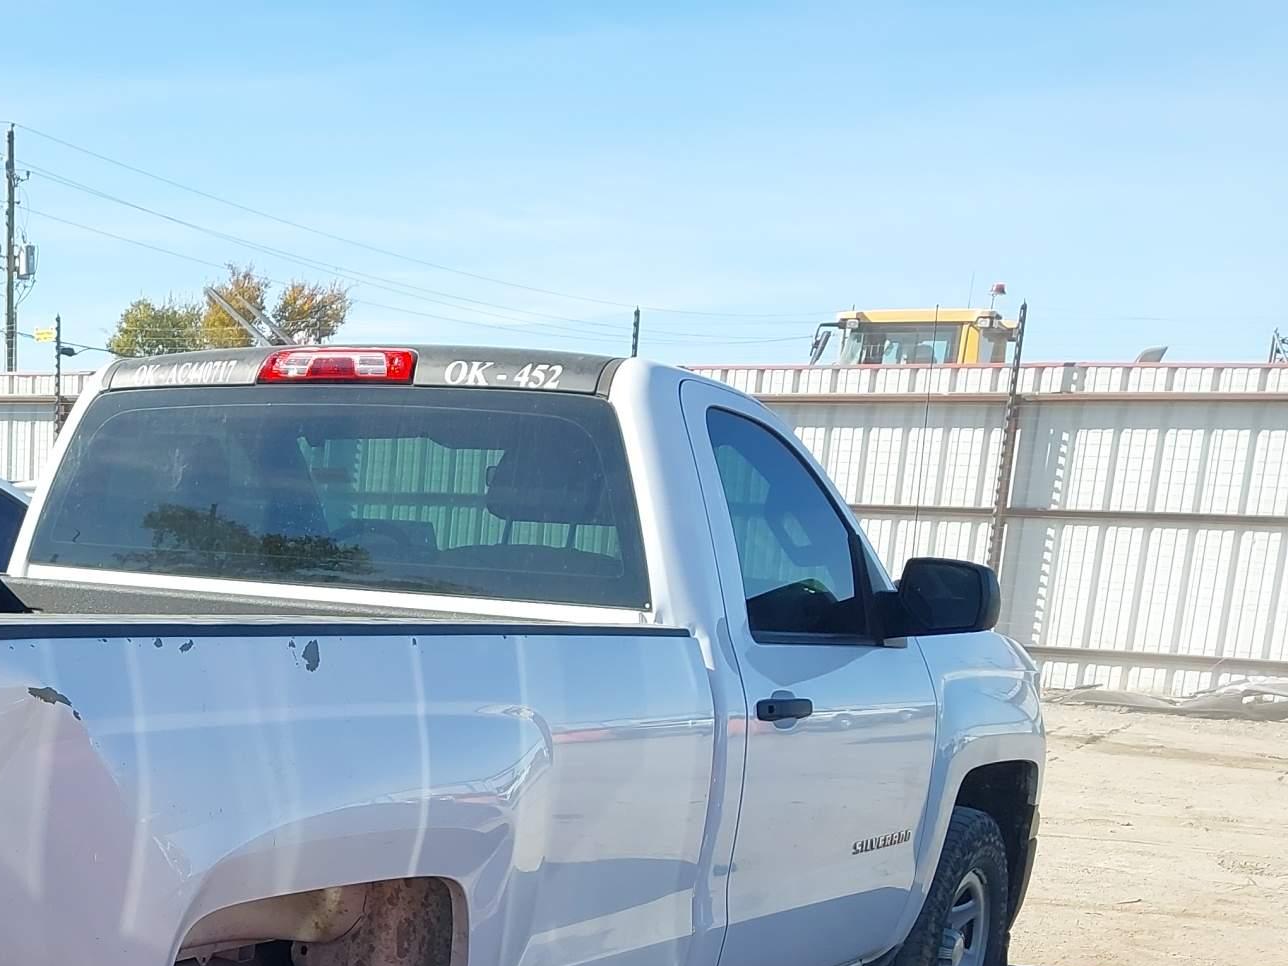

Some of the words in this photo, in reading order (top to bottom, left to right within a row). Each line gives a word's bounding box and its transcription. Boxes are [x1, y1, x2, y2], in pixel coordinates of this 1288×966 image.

[134, 365, 160, 385] OK
[444, 360, 487, 386] OK
[513, 364, 562, 389] 452
[852, 829, 912, 856] SILVERADO
